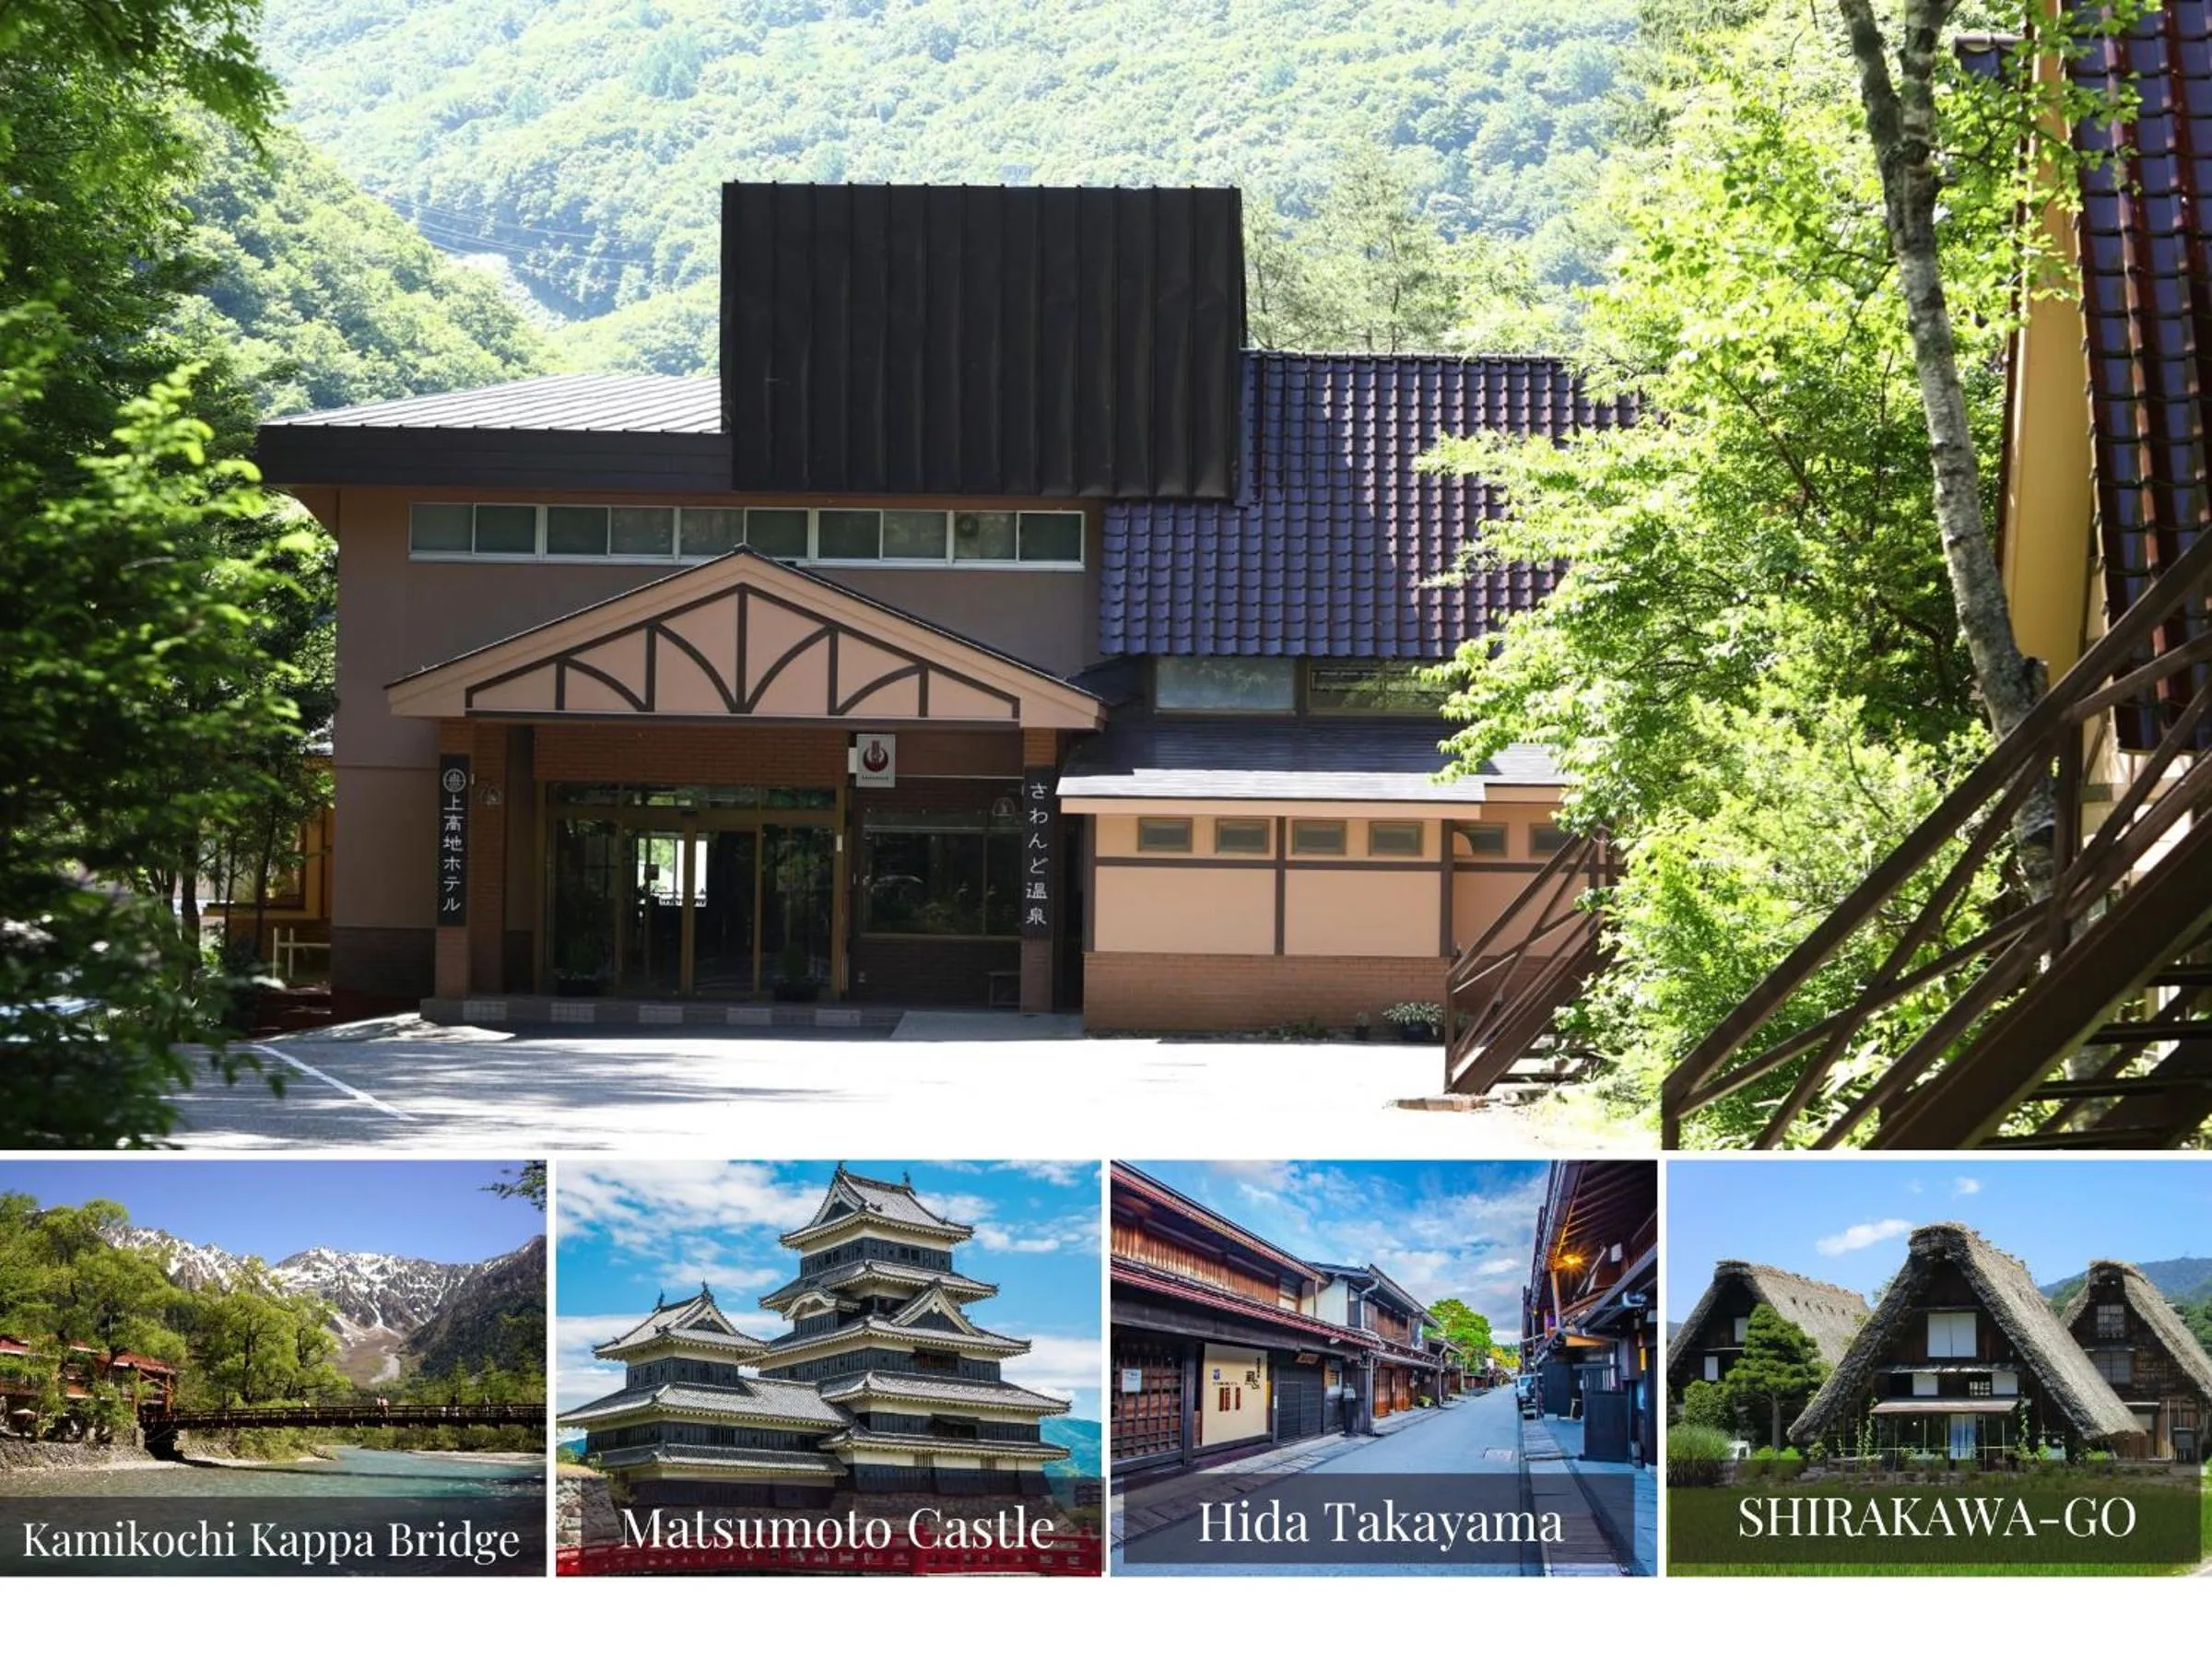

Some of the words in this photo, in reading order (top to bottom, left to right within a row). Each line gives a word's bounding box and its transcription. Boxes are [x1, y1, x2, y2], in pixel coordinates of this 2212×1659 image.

[442, 794, 465, 912] 上高地ホテル
[1026, 782, 1050, 925] さわんど温泉
